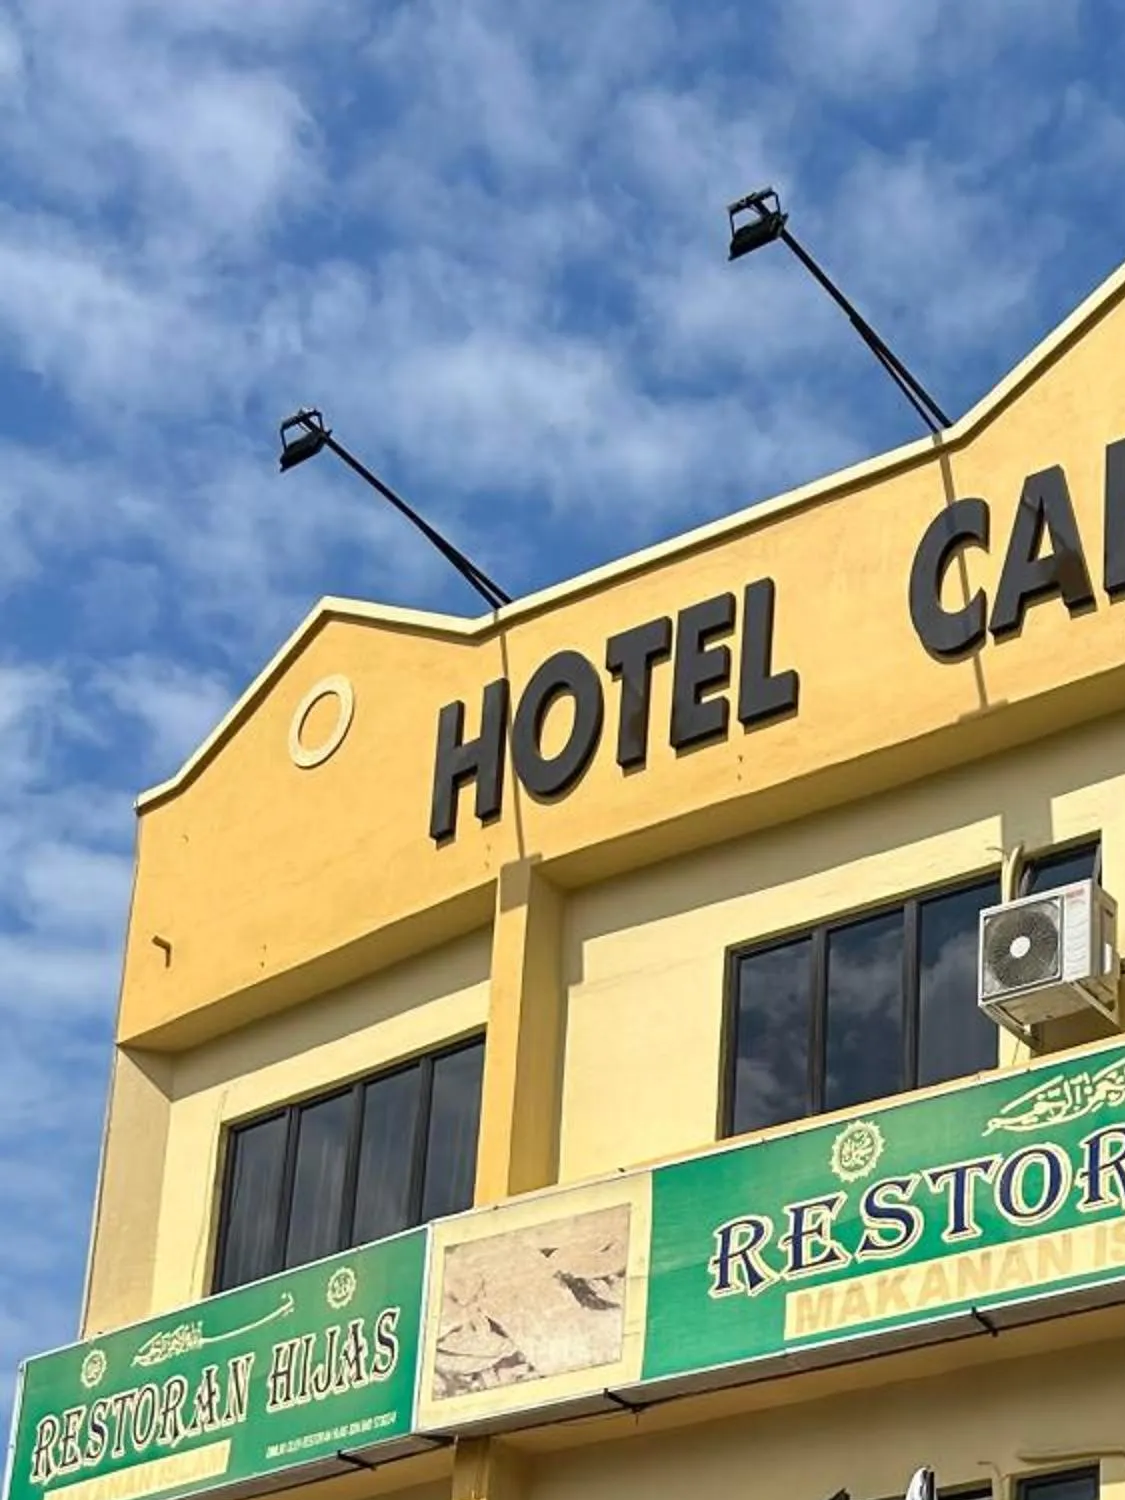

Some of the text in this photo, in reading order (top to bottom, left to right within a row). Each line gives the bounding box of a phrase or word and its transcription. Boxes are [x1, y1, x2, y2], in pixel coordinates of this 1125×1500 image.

[429, 576, 799, 840] HOTEL
[793, 1232, 1073, 1336] MAKANAN
[29, 1352, 256, 1485] RESTORAN
[266, 1306, 402, 1412] HIJAS
